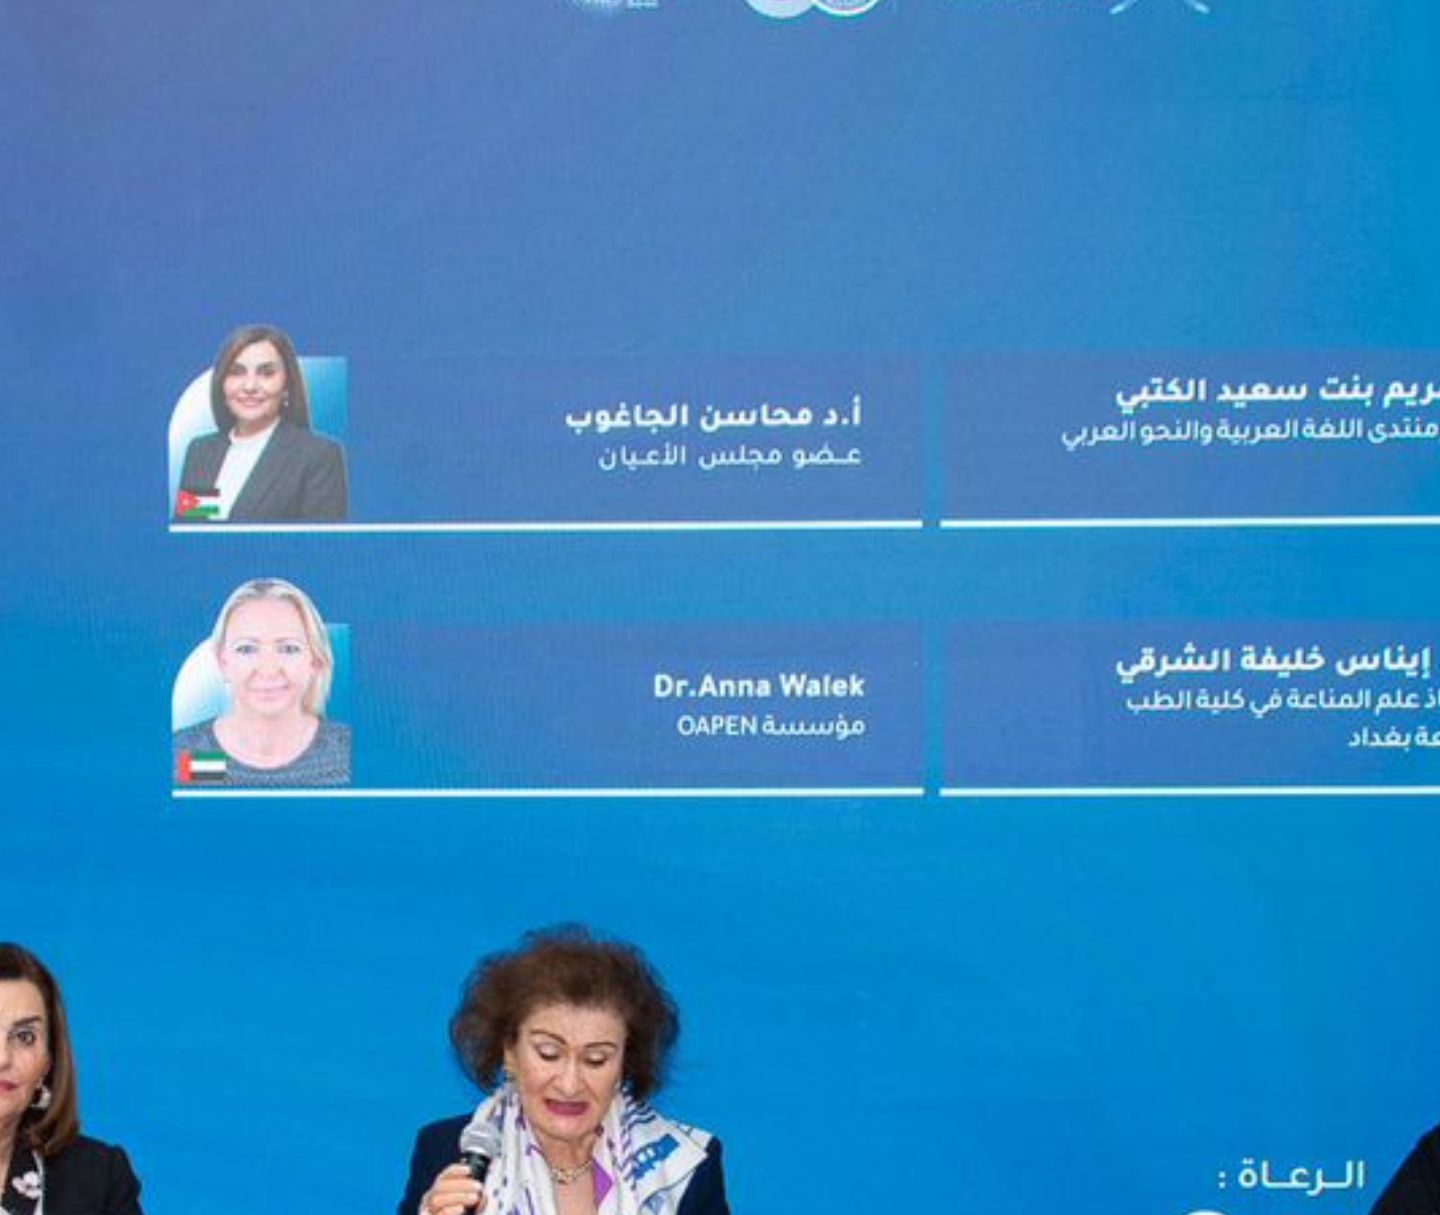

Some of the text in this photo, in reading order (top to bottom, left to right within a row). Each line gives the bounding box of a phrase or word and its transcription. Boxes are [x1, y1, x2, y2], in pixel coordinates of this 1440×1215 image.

[1115, 377, 1207, 414] الكتبي
[1216, 382, 1308, 408] سعيد
[1319, 374, 1375, 406] بنت
[565, 402, 689, 434] الجاغوب
[699, 403, 813, 433] محاسن
[1216, 418, 1299, 444] العربية
[1301, 417, 1364, 439] اللغة
[1367, 416, 1439, 444] منتدى
[1061, 420, 1136, 451] العربي
[1140, 420, 1213, 446] والنحو
[598, 442, 687, 471] الأعيان
[698, 444, 783, 470] مجلس
[1116, 642, 1231, 684] الشرقي
[1240, 645, 1326, 678] خليفة
[654, 673, 865, 698] Dr.Anna Walek
[1286, 688, 1371, 710] المناعة
[1126, 689, 1192, 712] الطب
[1196, 688, 1245, 714] كلية
[1249, 688, 1283, 719] في
[1374, 688, 1421, 716] علم
[677, 713, 866, 741] مؤسسة OAPEN
[1348, 726, 1411, 748] بغداد
[1238, 1157, 1365, 1197] الرعاة
